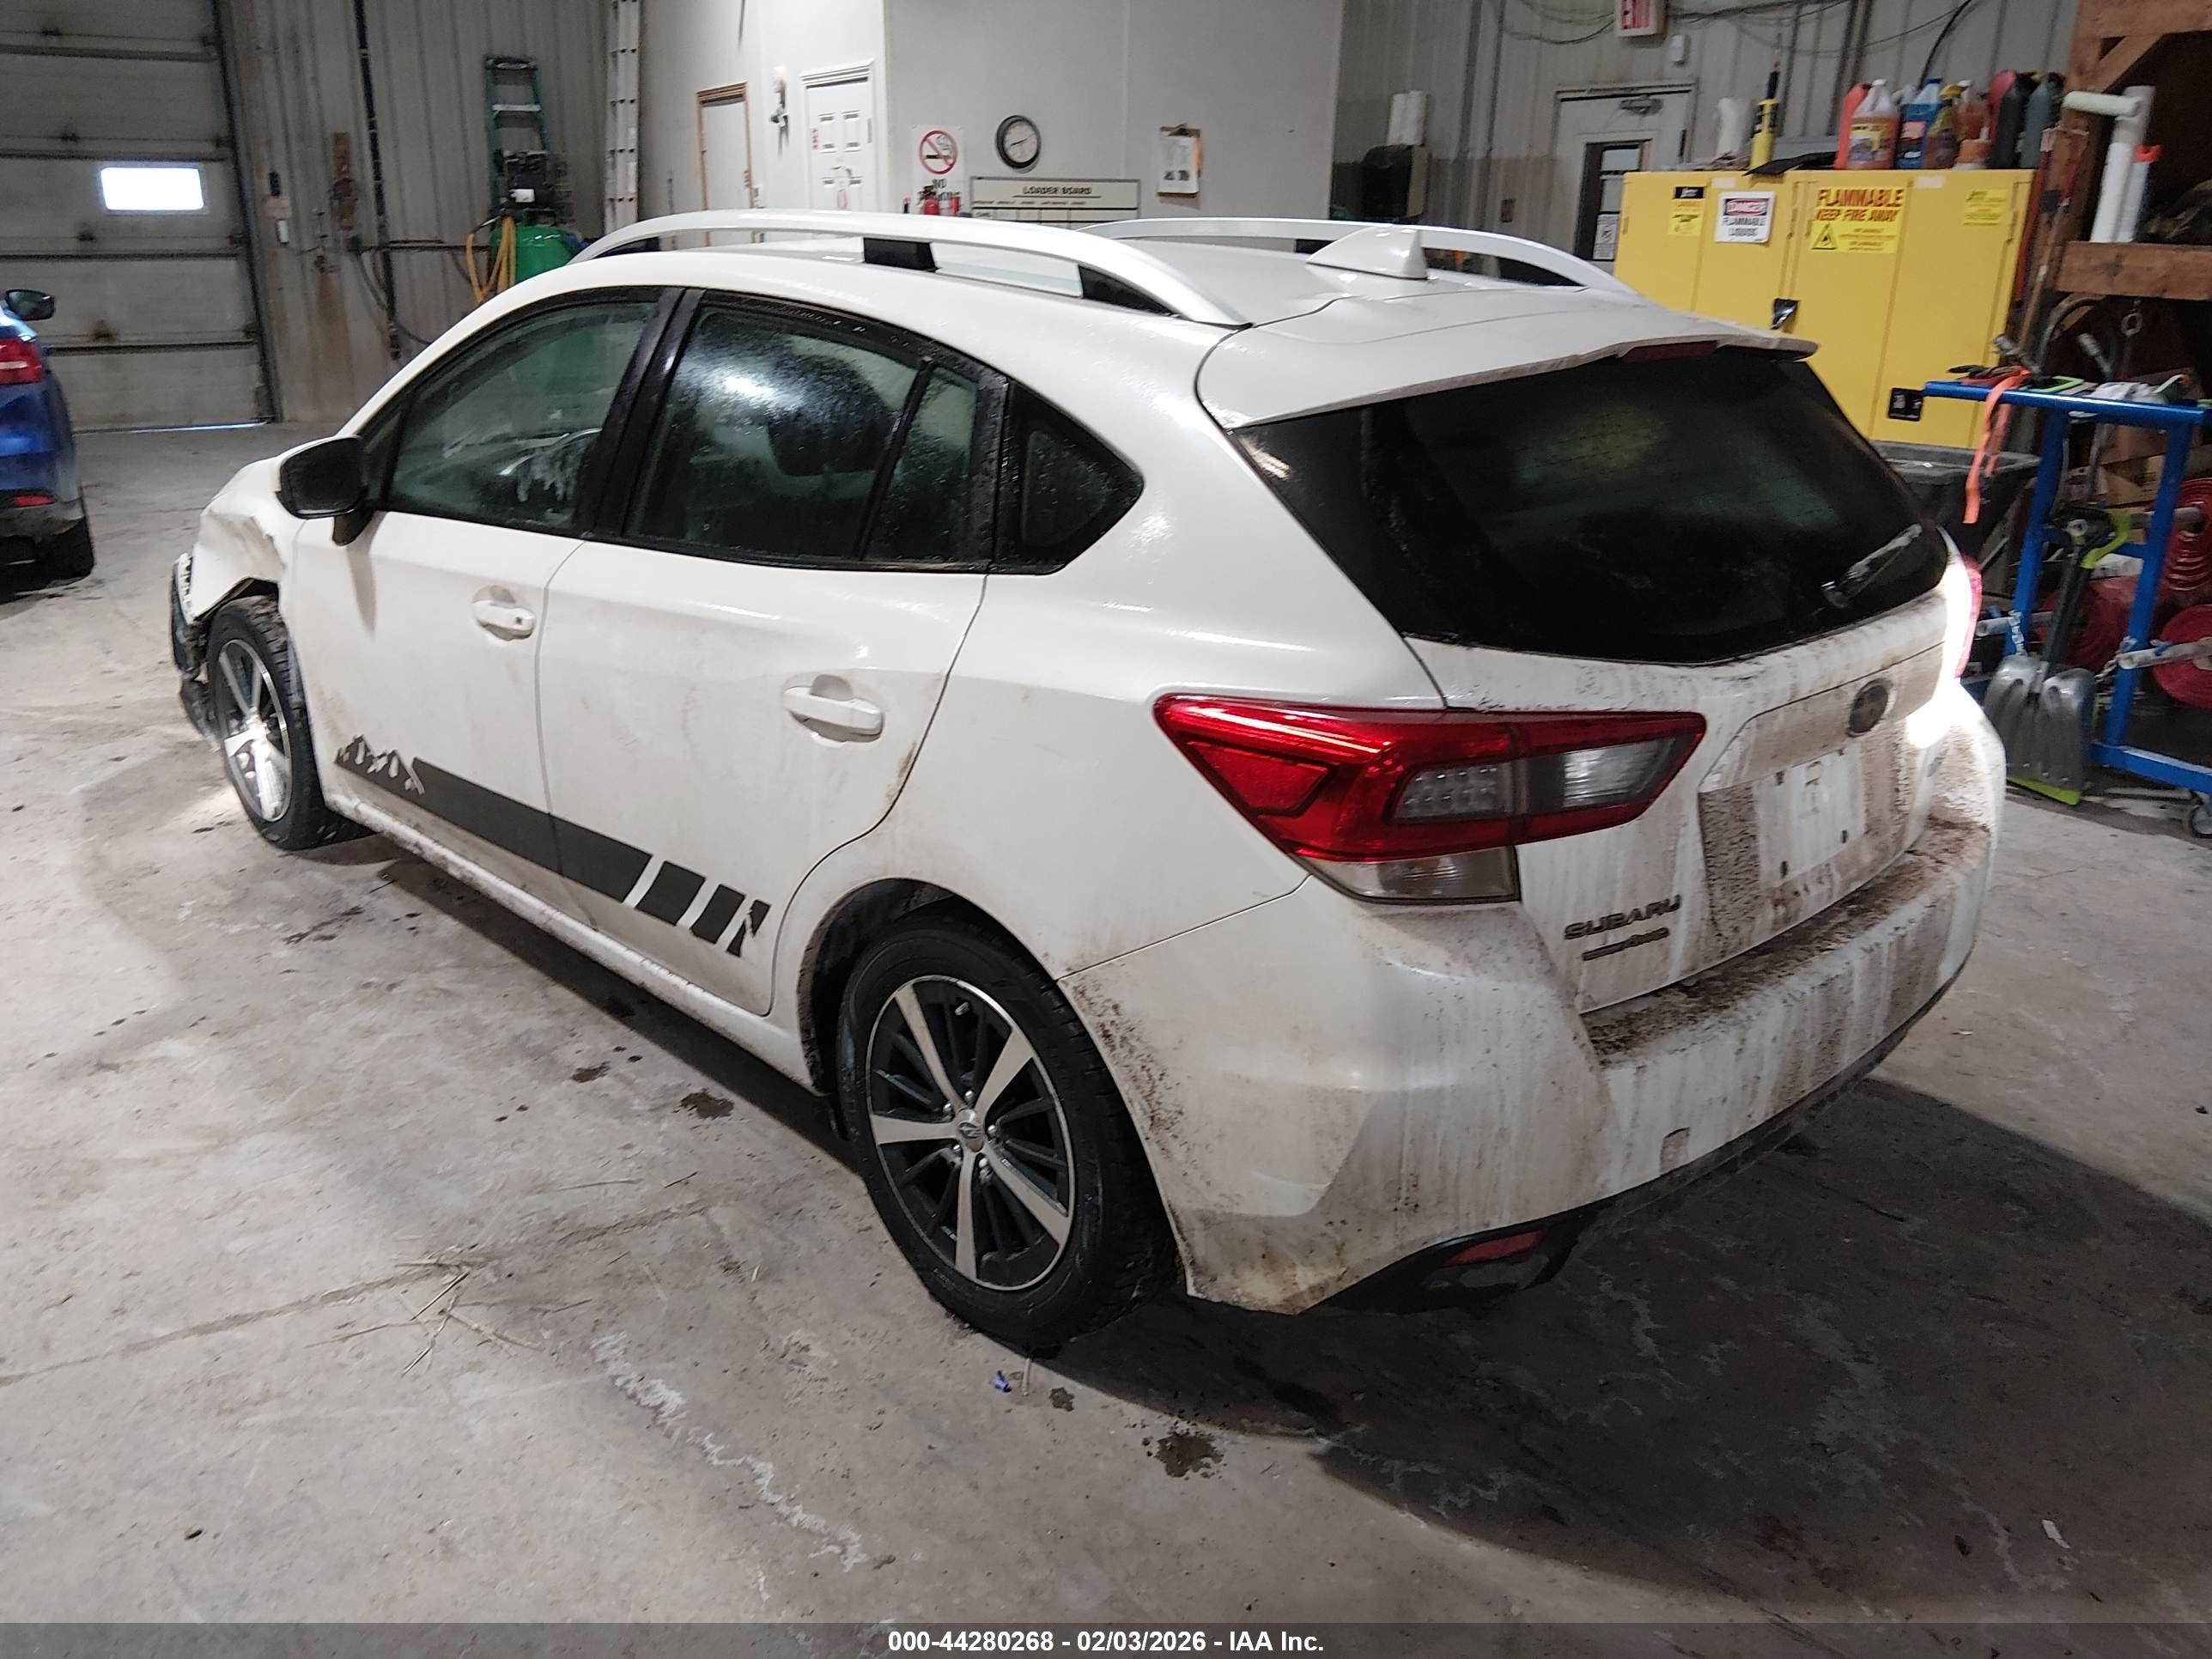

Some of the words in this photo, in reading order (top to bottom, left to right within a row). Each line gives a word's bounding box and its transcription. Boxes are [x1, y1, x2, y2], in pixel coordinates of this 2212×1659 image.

[1816, 188, 1905, 207] FLAMMABLE
[1815, 209, 1841, 222] KEEP
[1842, 209, 1868, 222] FIRE
[1868, 209, 1899, 222] AWAY
[1563, 894, 1682, 940] SUBARU
